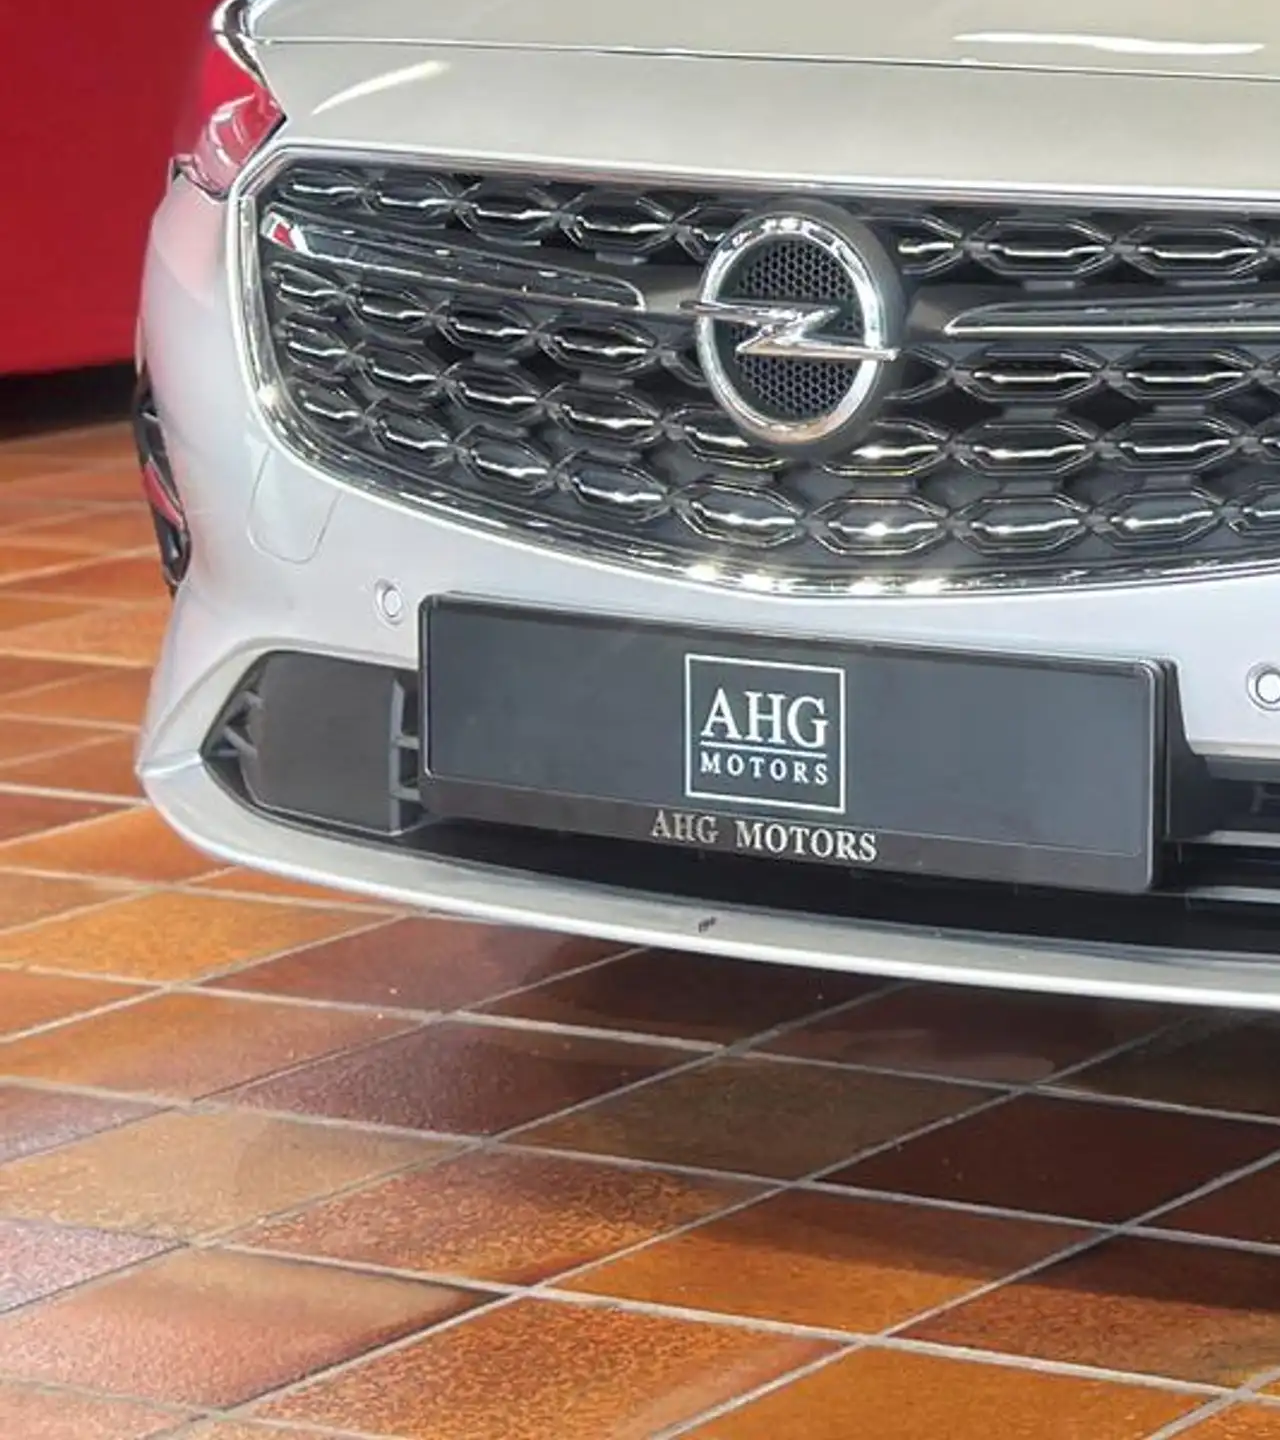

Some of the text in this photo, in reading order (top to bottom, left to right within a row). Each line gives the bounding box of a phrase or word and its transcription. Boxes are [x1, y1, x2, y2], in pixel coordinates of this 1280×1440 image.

[700, 687, 829, 749] AHG
[700, 751, 829, 786] MOTORS
[652, 809, 878, 862] AHG MOTORS
